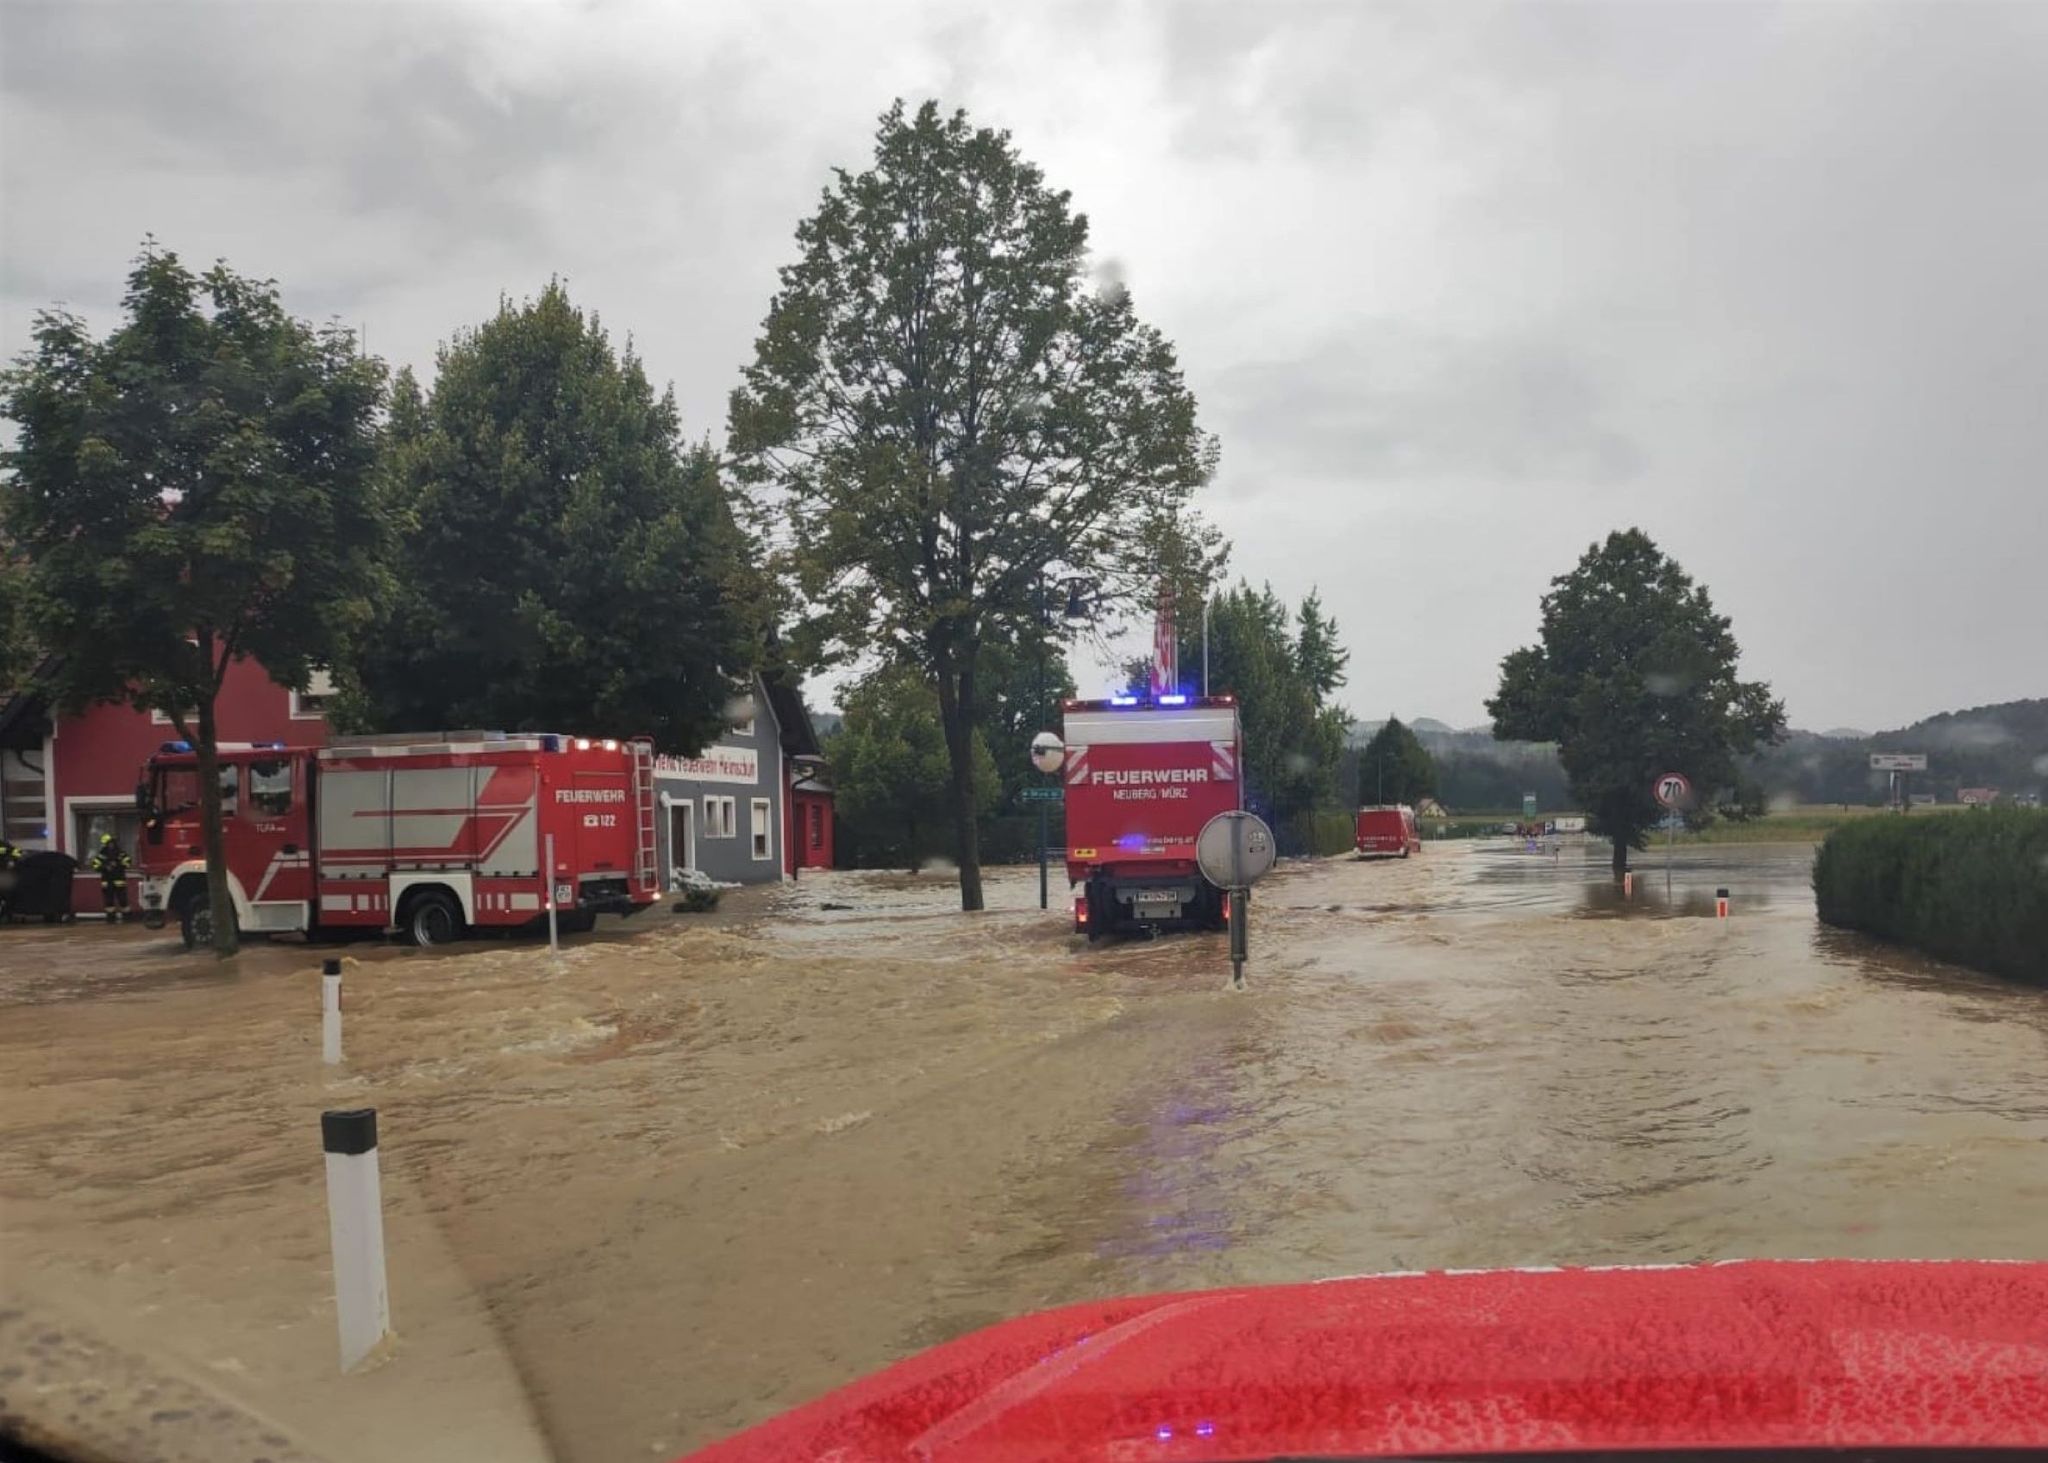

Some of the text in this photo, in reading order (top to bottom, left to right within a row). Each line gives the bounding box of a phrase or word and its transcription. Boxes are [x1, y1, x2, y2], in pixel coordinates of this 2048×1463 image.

[1092, 768, 1208, 785] FEUERWEHR
[555, 789, 625, 804] FEUERWEHR
[1113, 786, 1188, 800] NEUBERG MÜRZ
[1663, 781, 1682, 799] 70
[600, 814, 616, 827] 122
